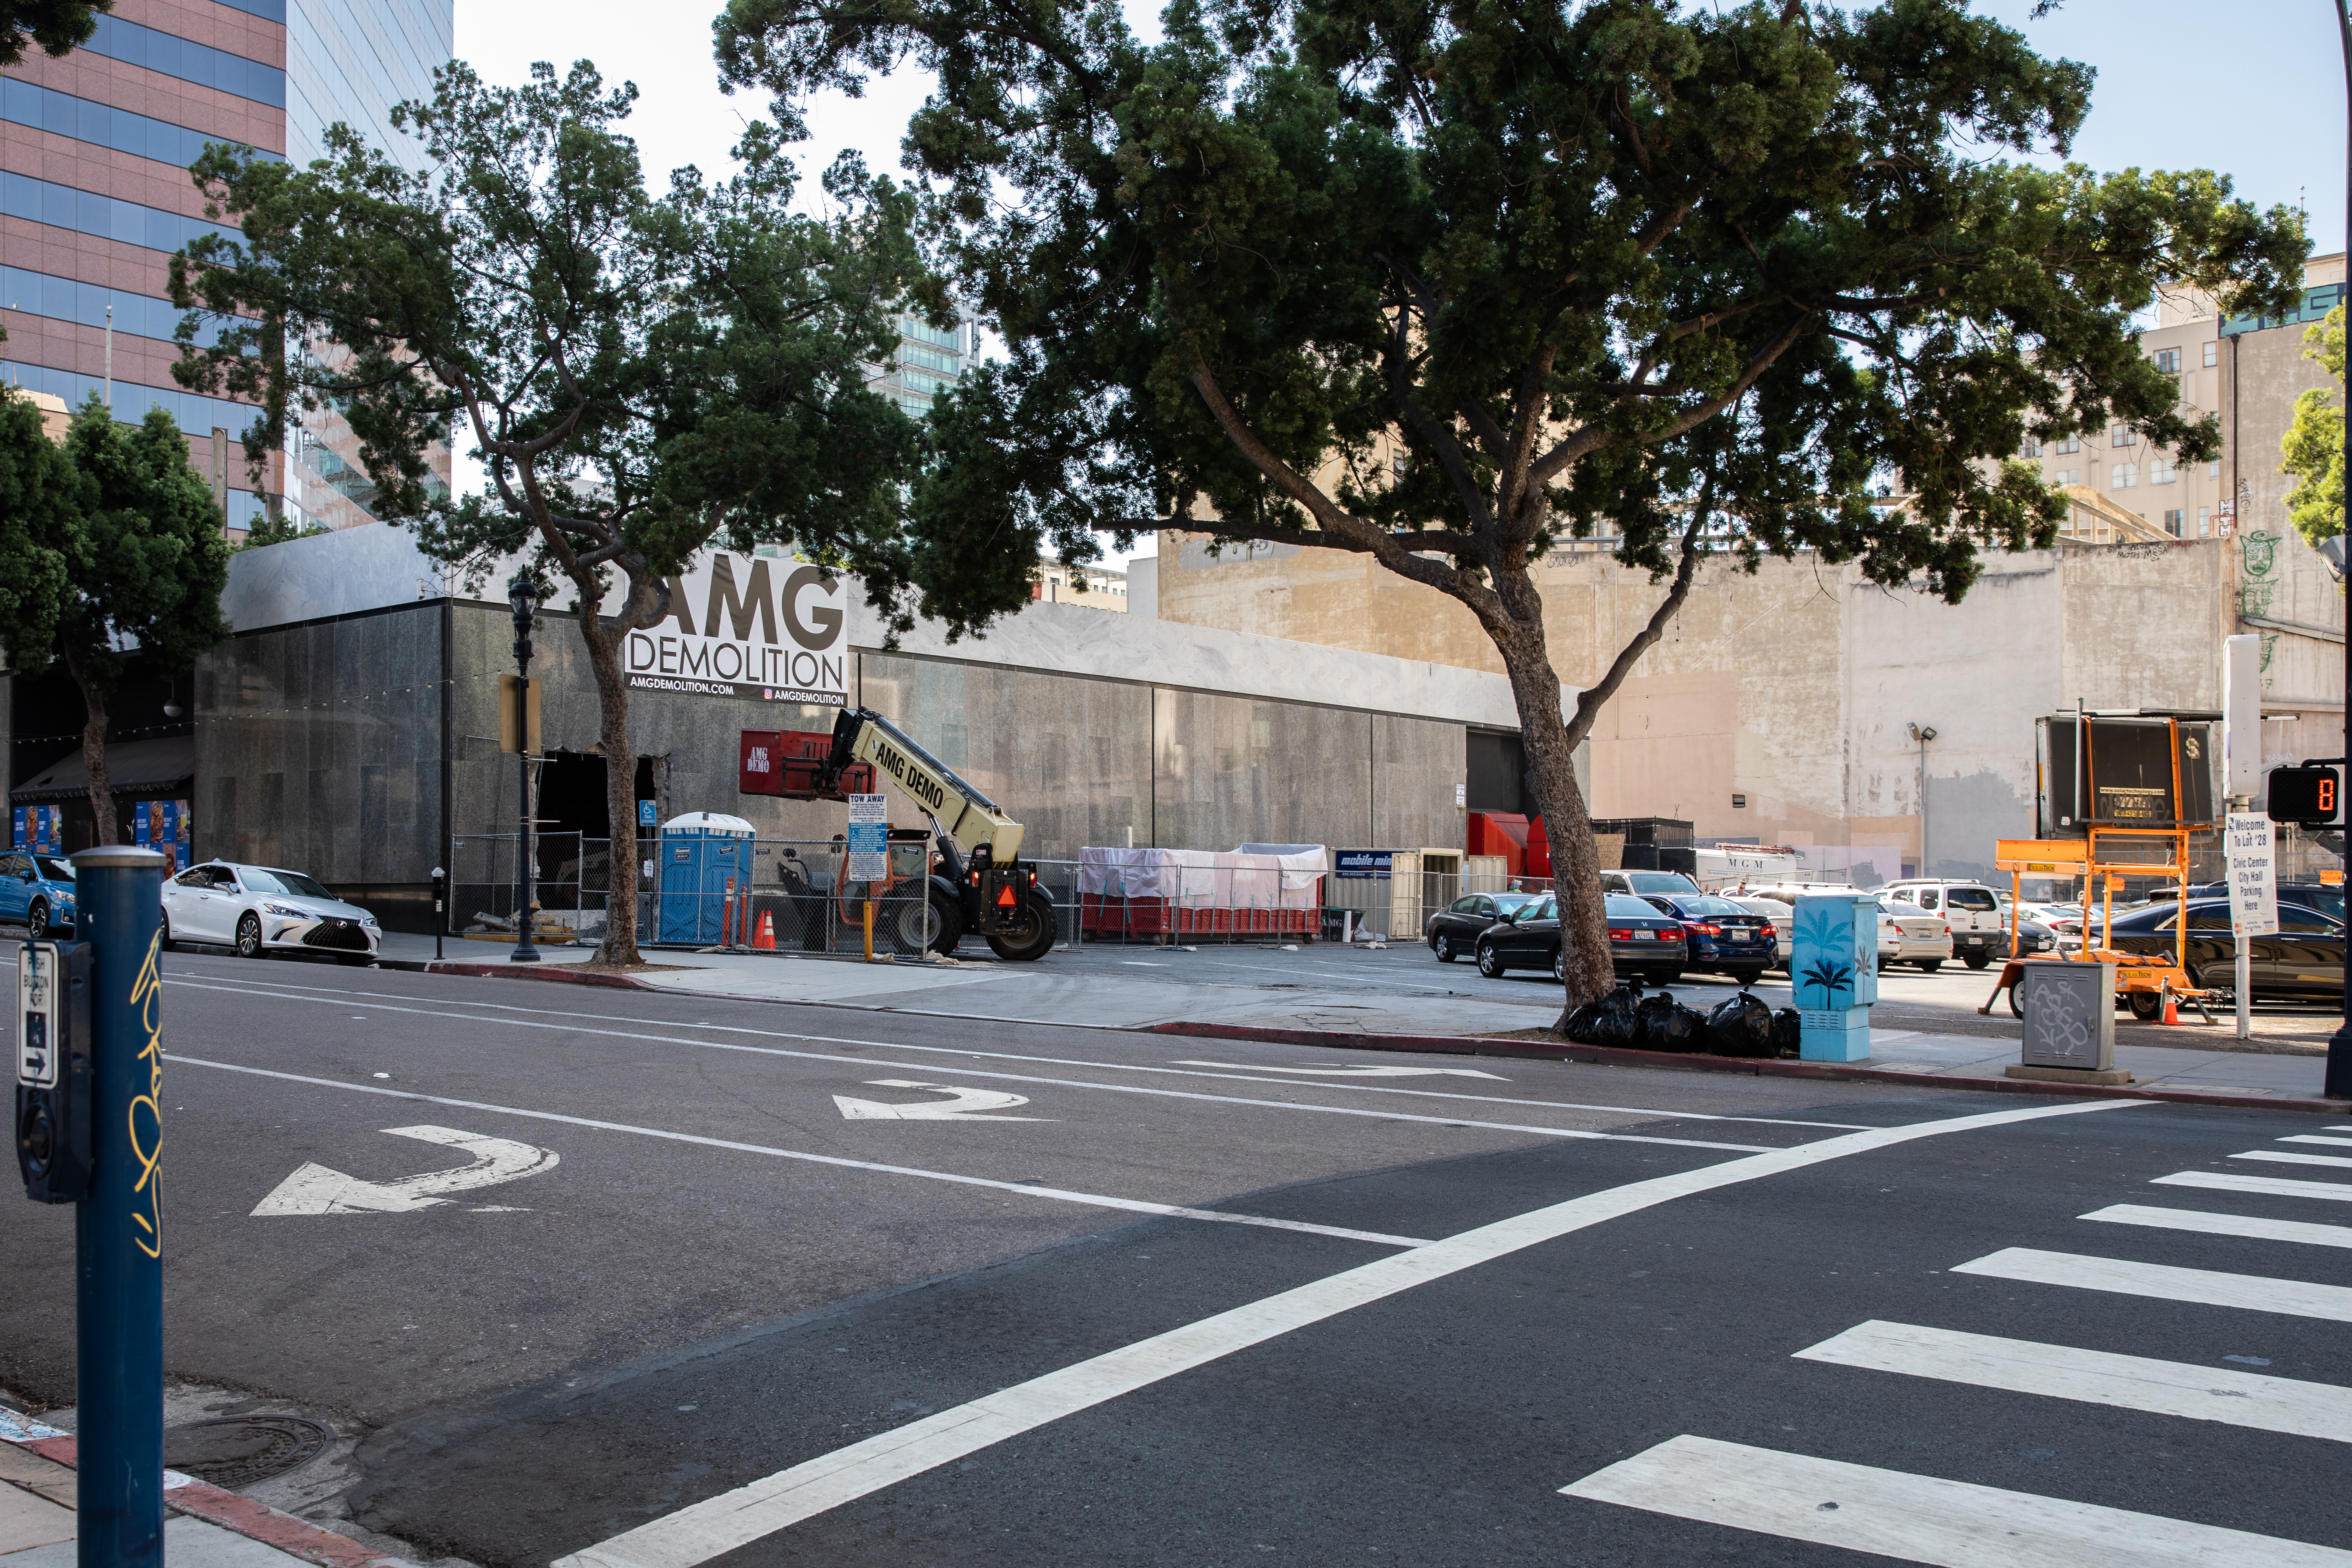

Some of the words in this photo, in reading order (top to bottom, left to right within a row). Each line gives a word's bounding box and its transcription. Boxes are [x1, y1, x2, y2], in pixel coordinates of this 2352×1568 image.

[630, 632, 842, 690] DEMOLITION
[630, 676, 734, 695] AMGDEMOLITION.COM
[774, 690, 844, 705] AMGDEMOLITION
[750, 747, 767, 760] AMG
[747, 759, 769, 773] DEMO
[875, 742, 904, 780] AMG
[906, 765, 943, 810] DEMO
[2319, 779, 2334, 810] 8
[2235, 819, 2265, 831] Welcome
[2234, 836, 2241, 847] To
[2243, 835, 2252, 846] Lot
[2254, 834, 2266, 845] #28
[1341, 854, 1373, 865] mobile
[1374, 856, 1392, 865] min
[2233, 858, 2246, 868] Civic
[2248, 857, 2268, 867] Center
[2239, 872, 2249, 884] City
[2250, 871, 2263, 881] Hall
[2240, 885, 2262, 898] Parking
[2245, 900, 2258, 911] Here
[28, 957, 45, 970] PSH
[24, 975, 49, 988] BUTTON
[30, 994, 42, 1006] FOR
